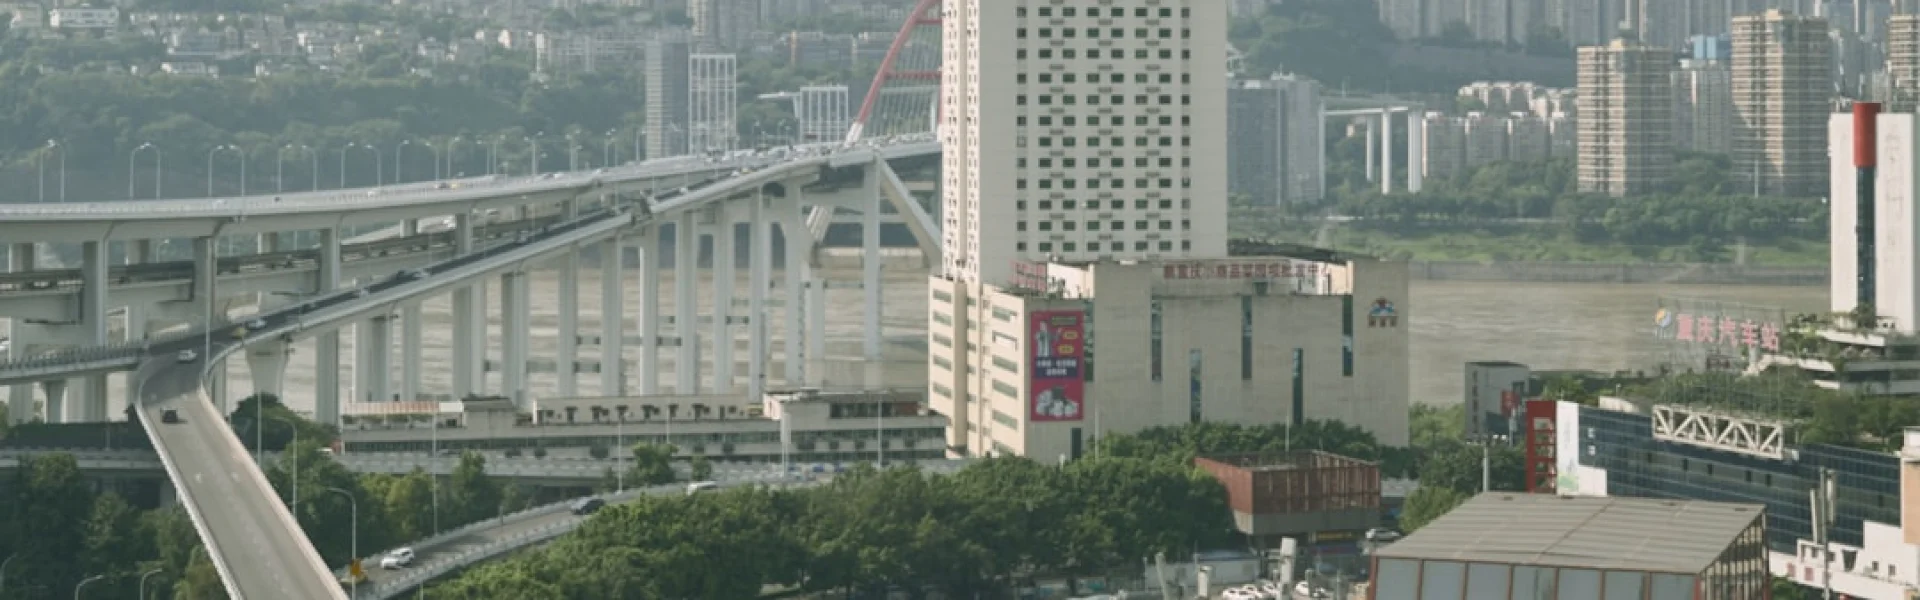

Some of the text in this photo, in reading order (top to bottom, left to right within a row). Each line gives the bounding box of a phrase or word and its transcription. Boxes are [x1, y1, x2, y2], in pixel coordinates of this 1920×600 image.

[1676, 313, 1779, 351] 重庆汽车站
